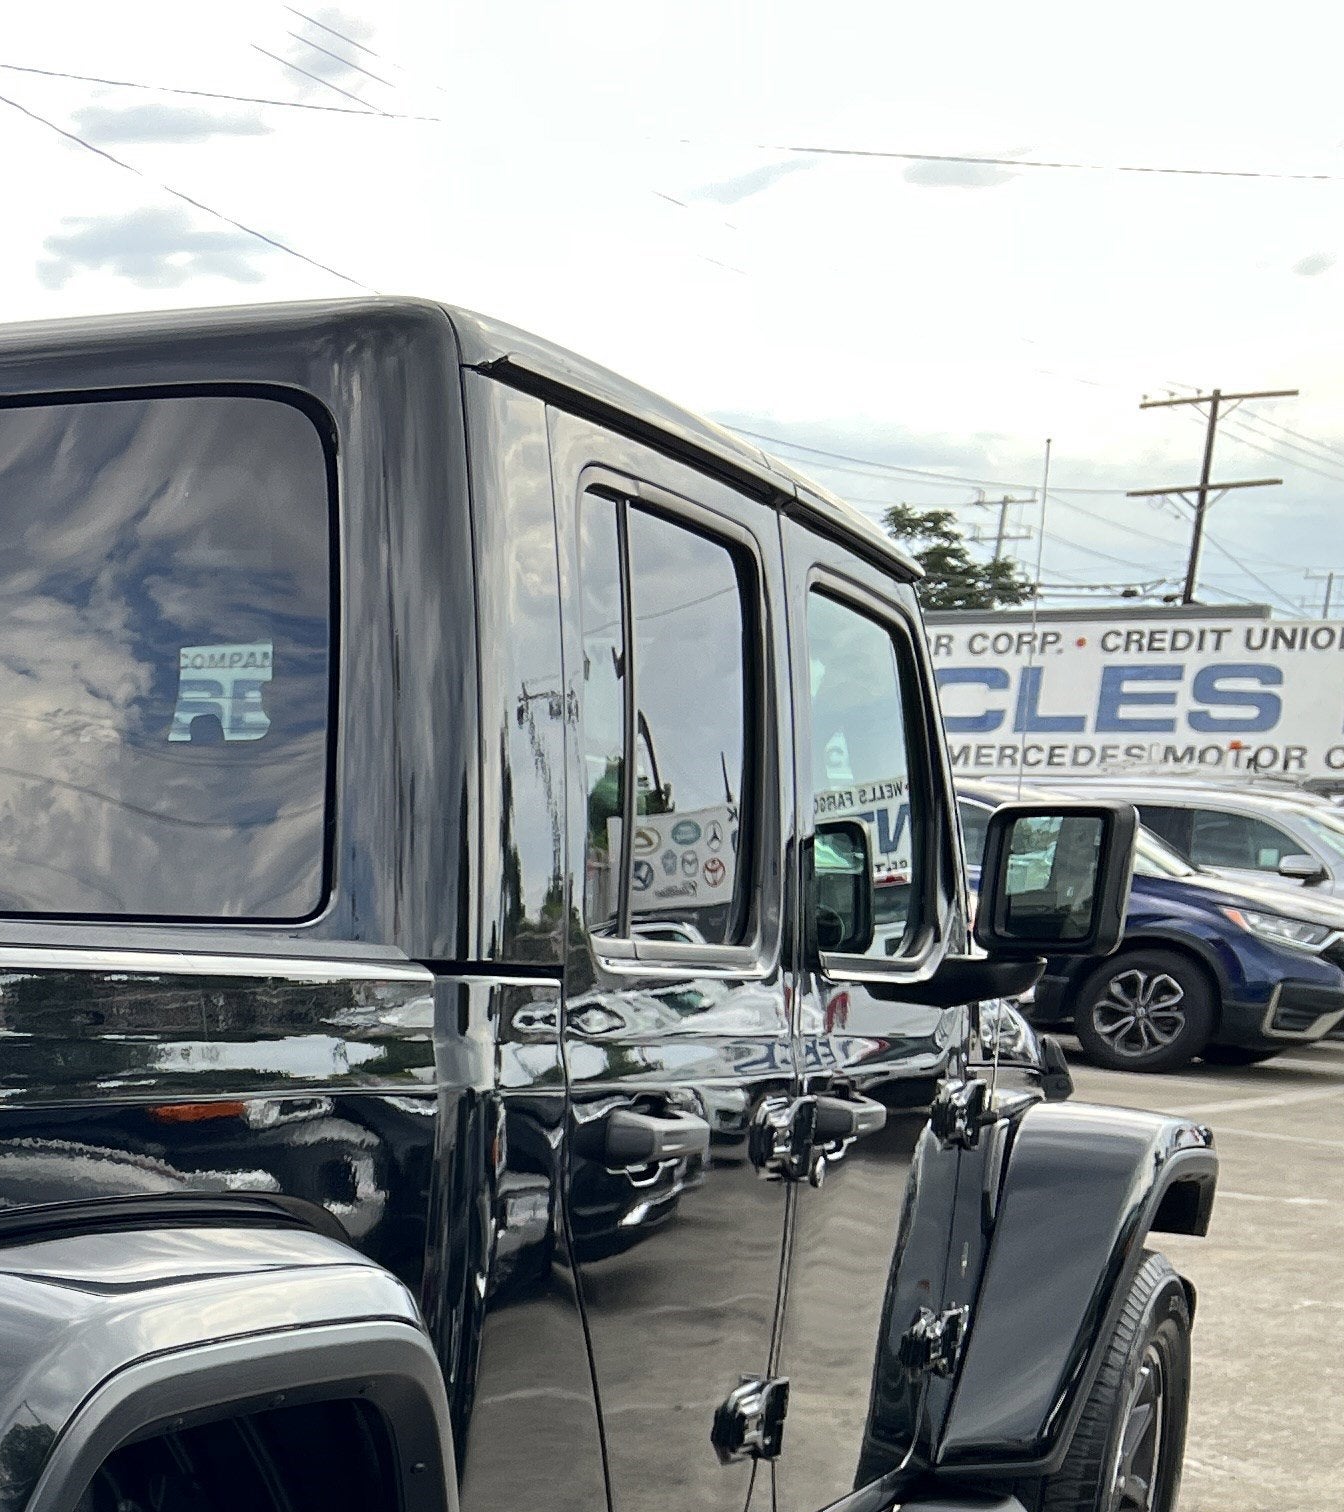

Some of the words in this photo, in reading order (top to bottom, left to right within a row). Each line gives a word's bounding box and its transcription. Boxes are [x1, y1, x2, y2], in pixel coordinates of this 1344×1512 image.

[968, 631, 1063, 656] CORP.
[1101, 628, 1231, 653] CREDIT
[933, 663, 1284, 733] CLES
[1163, 743, 1308, 771] MOTOR
